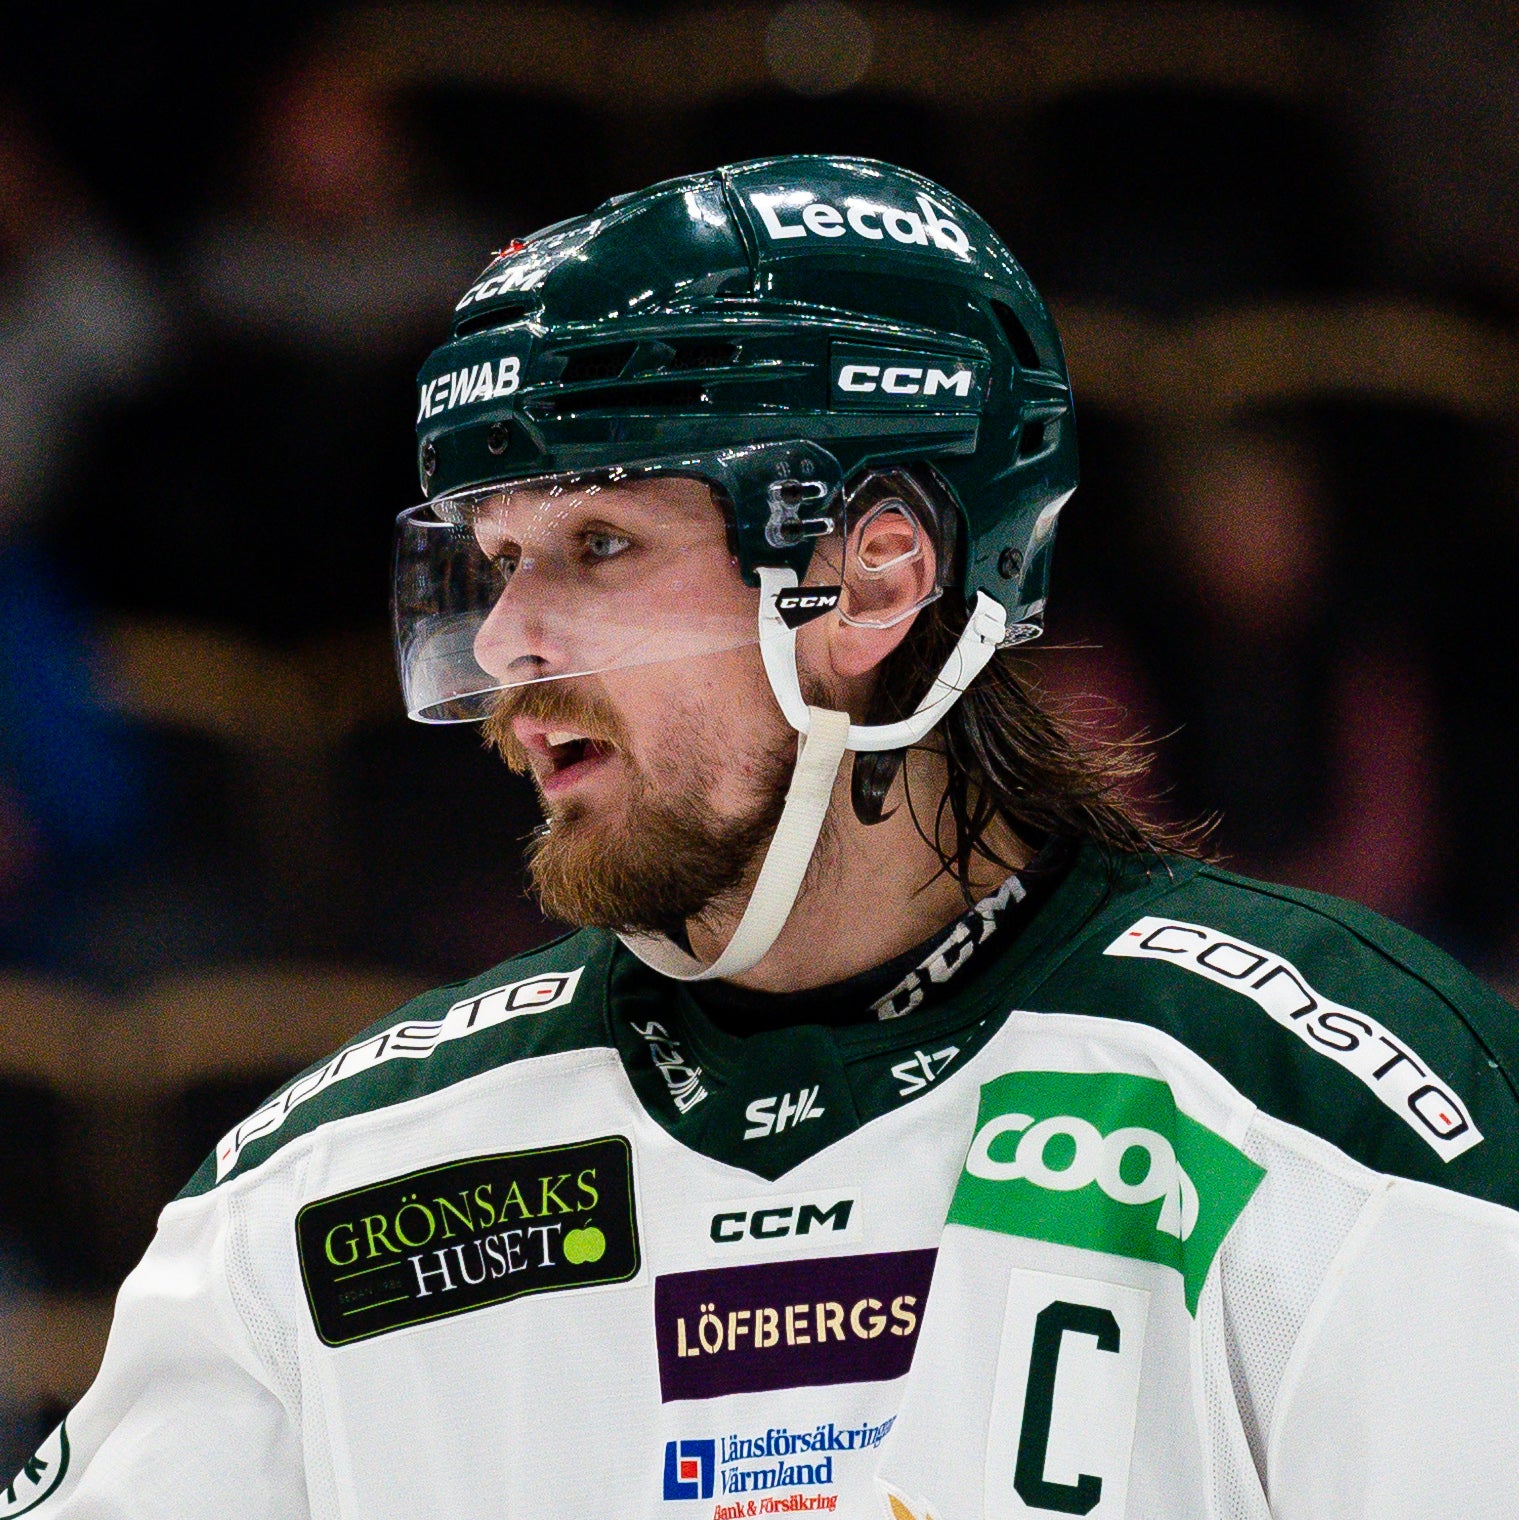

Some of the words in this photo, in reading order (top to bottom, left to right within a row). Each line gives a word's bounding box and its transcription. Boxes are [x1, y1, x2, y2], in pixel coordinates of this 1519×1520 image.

[750, 191, 976, 263] Lecab
[837, 364, 972, 397] CCM
[779, 592, 839, 610] CCM
[867, 874, 1028, 1022] CCM
[741, 1083, 826, 1140] SHL
[323, 1167, 602, 1268] GRÖNSAKS
[709, 1199, 855, 1245] CCM
[406, 1222, 564, 1300] HUSET
[676, 1293, 918, 1359] LÖFBERGS
[1013, 1299, 1122, 1517] C
[720, 1456, 834, 1496] Värmland
[746, 1500, 758, 1517] &
[758, 1493, 839, 1516] Försäkring
